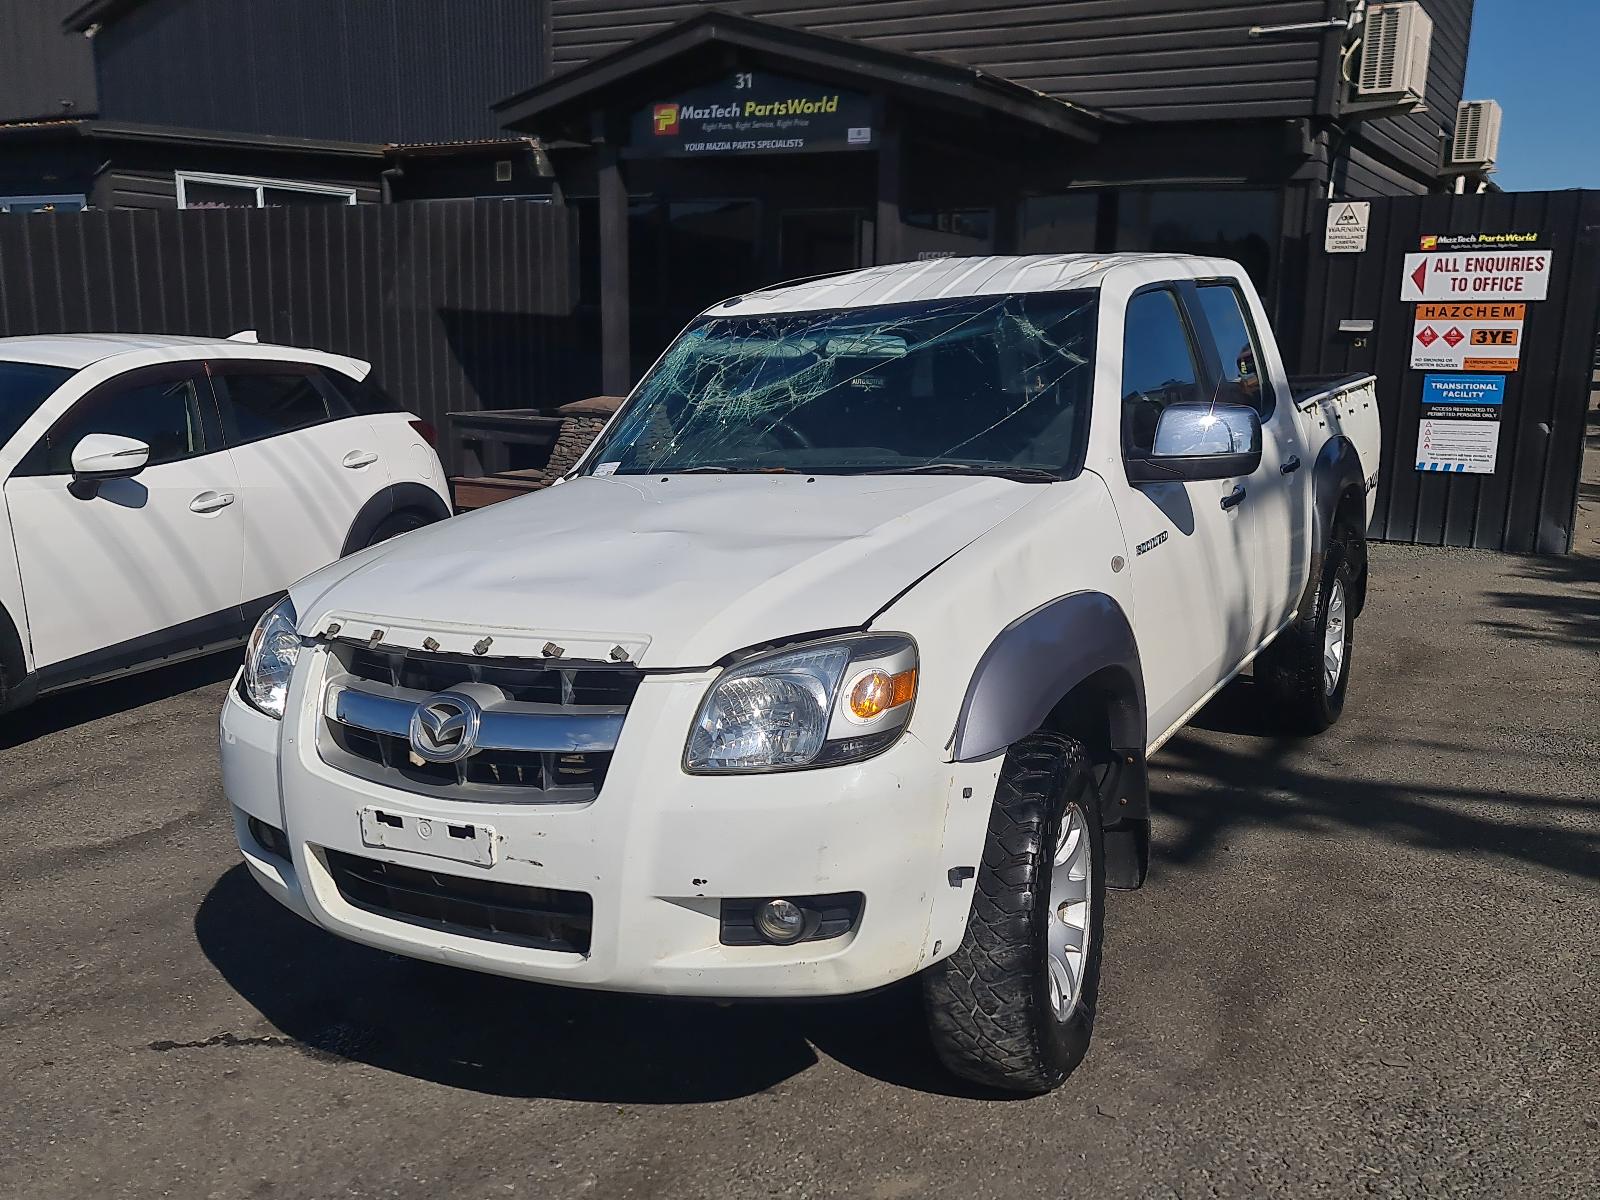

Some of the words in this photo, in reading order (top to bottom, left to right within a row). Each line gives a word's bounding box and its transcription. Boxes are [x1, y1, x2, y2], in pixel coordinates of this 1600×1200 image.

[736, 72, 752, 89] 31
[680, 102, 741, 119] MazTech
[744, 96, 839, 116] PartsWorld
[684, 143, 705, 151] YOUR
[705, 142, 731, 151] MAZDA
[732, 141, 756, 150] PARTS
[757, 139, 804, 149] SPECIALISTS
[1437, 235, 1477, 244] MazTech
[1478, 232, 1538, 243] PartsWorld
[1433, 258, 1460, 273] ALL
[1464, 256, 1545, 273] ENQUIRIES
[1450, 277, 1468, 292] TO
[1472, 276, 1524, 292] OFFICE
[1425, 306, 1516, 317] HAZCHEM
[1475, 330, 1513, 344] 3YE
[1431, 382, 1499, 391] TRANSITIONAL
[1442, 390, 1484, 398] FACILITY
